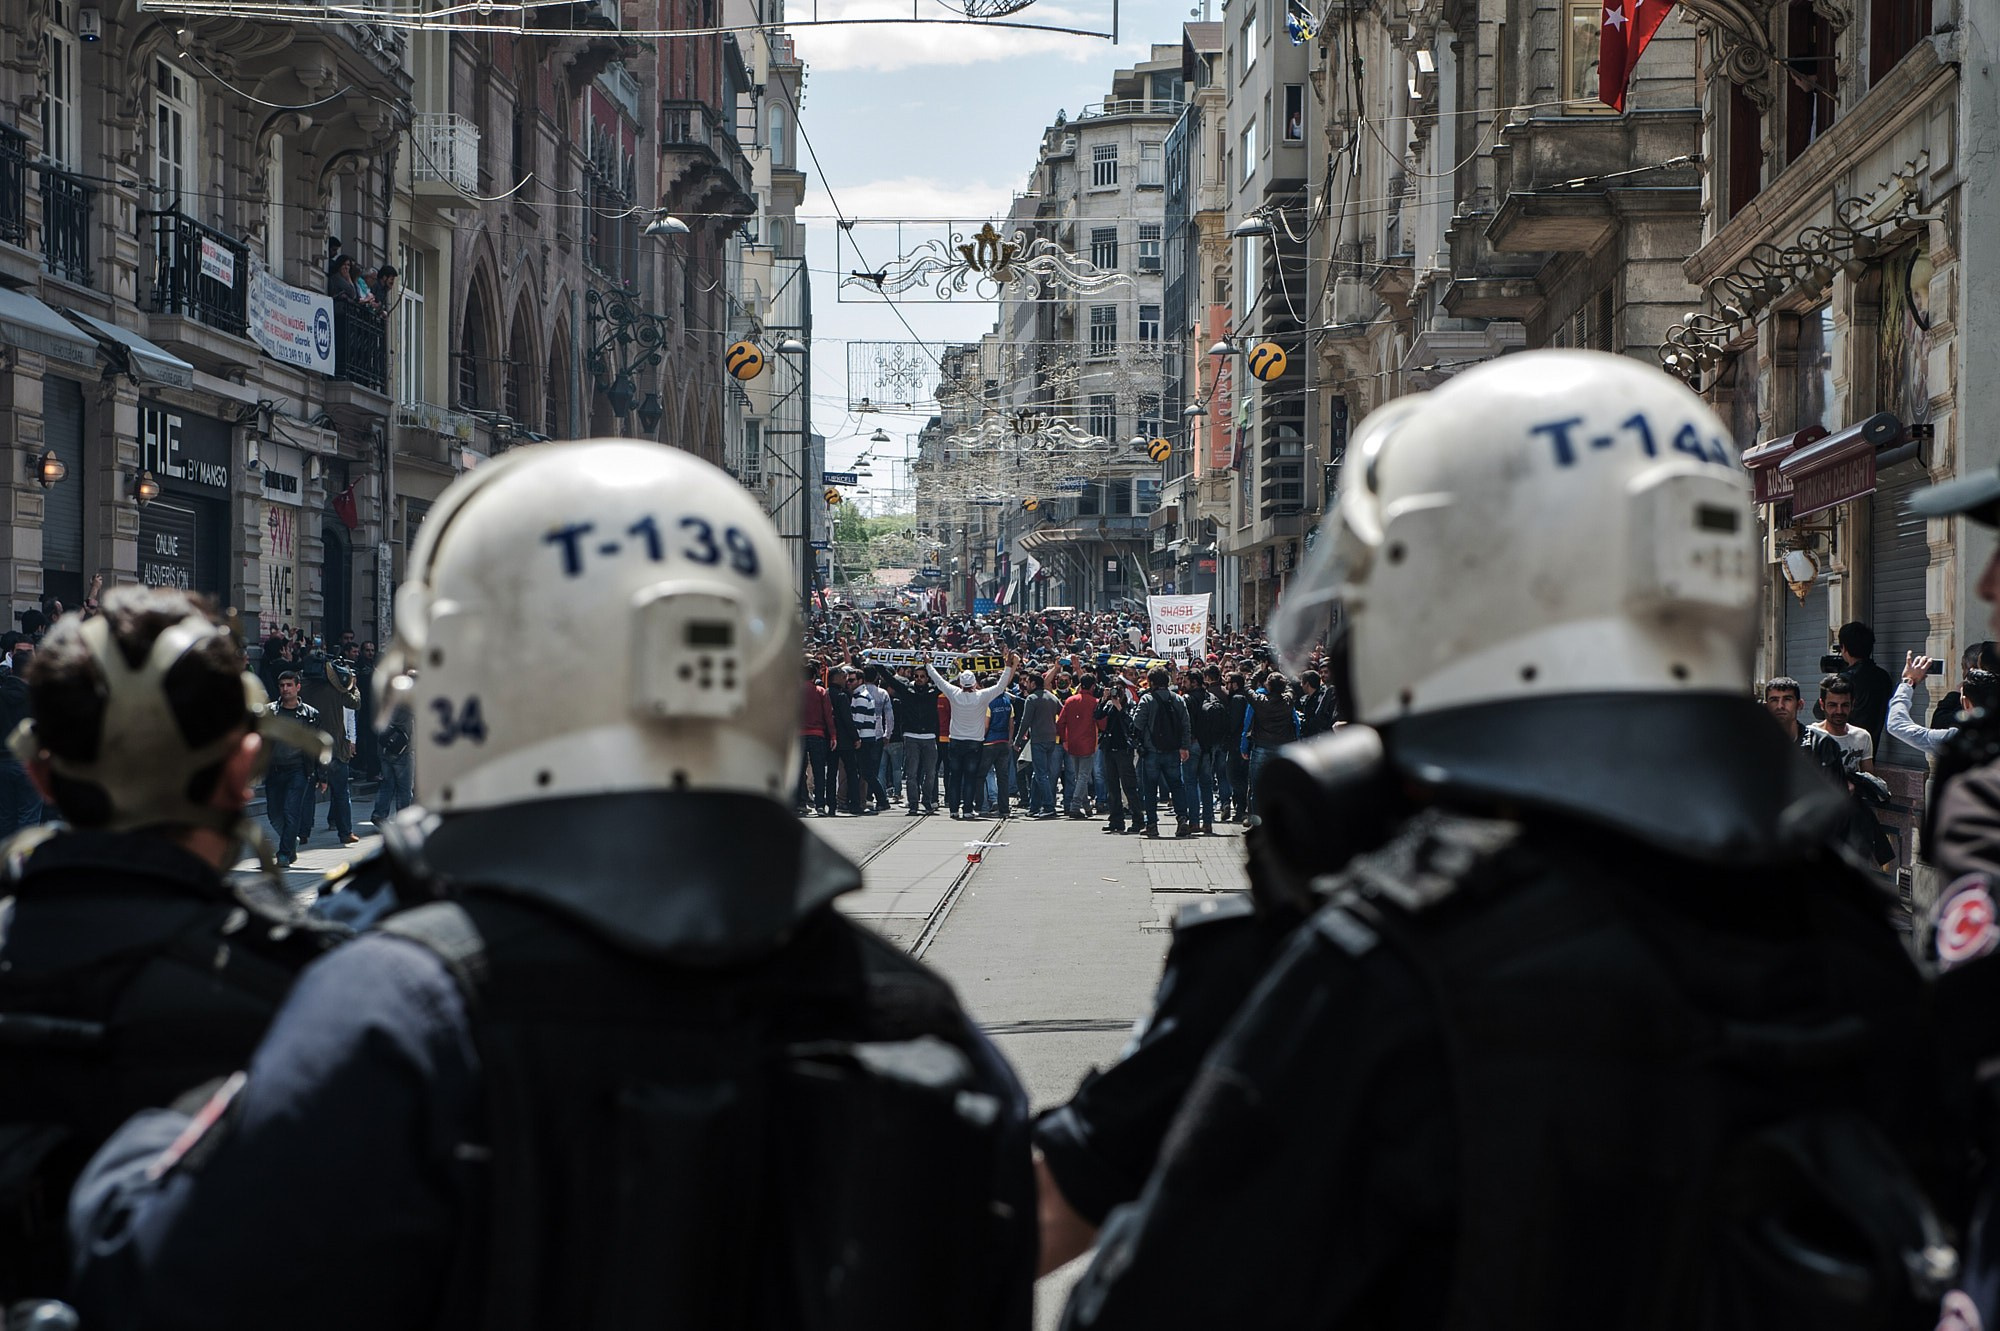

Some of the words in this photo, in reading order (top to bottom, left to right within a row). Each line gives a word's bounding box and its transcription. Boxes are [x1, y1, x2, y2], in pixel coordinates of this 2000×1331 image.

[187, 459, 199, 481] BY
[200, 461, 227, 488] MANGO
[1798, 471, 1831, 509] TURKISH
[1834, 455, 1872, 500] DELIGHT
[155, 533, 178, 557] ONLINE
[540, 512, 763, 579] T-139
[269, 564, 291, 616] WE
[1169, 637, 1190, 647] AGAINST
[429, 694, 489, 748] 34
